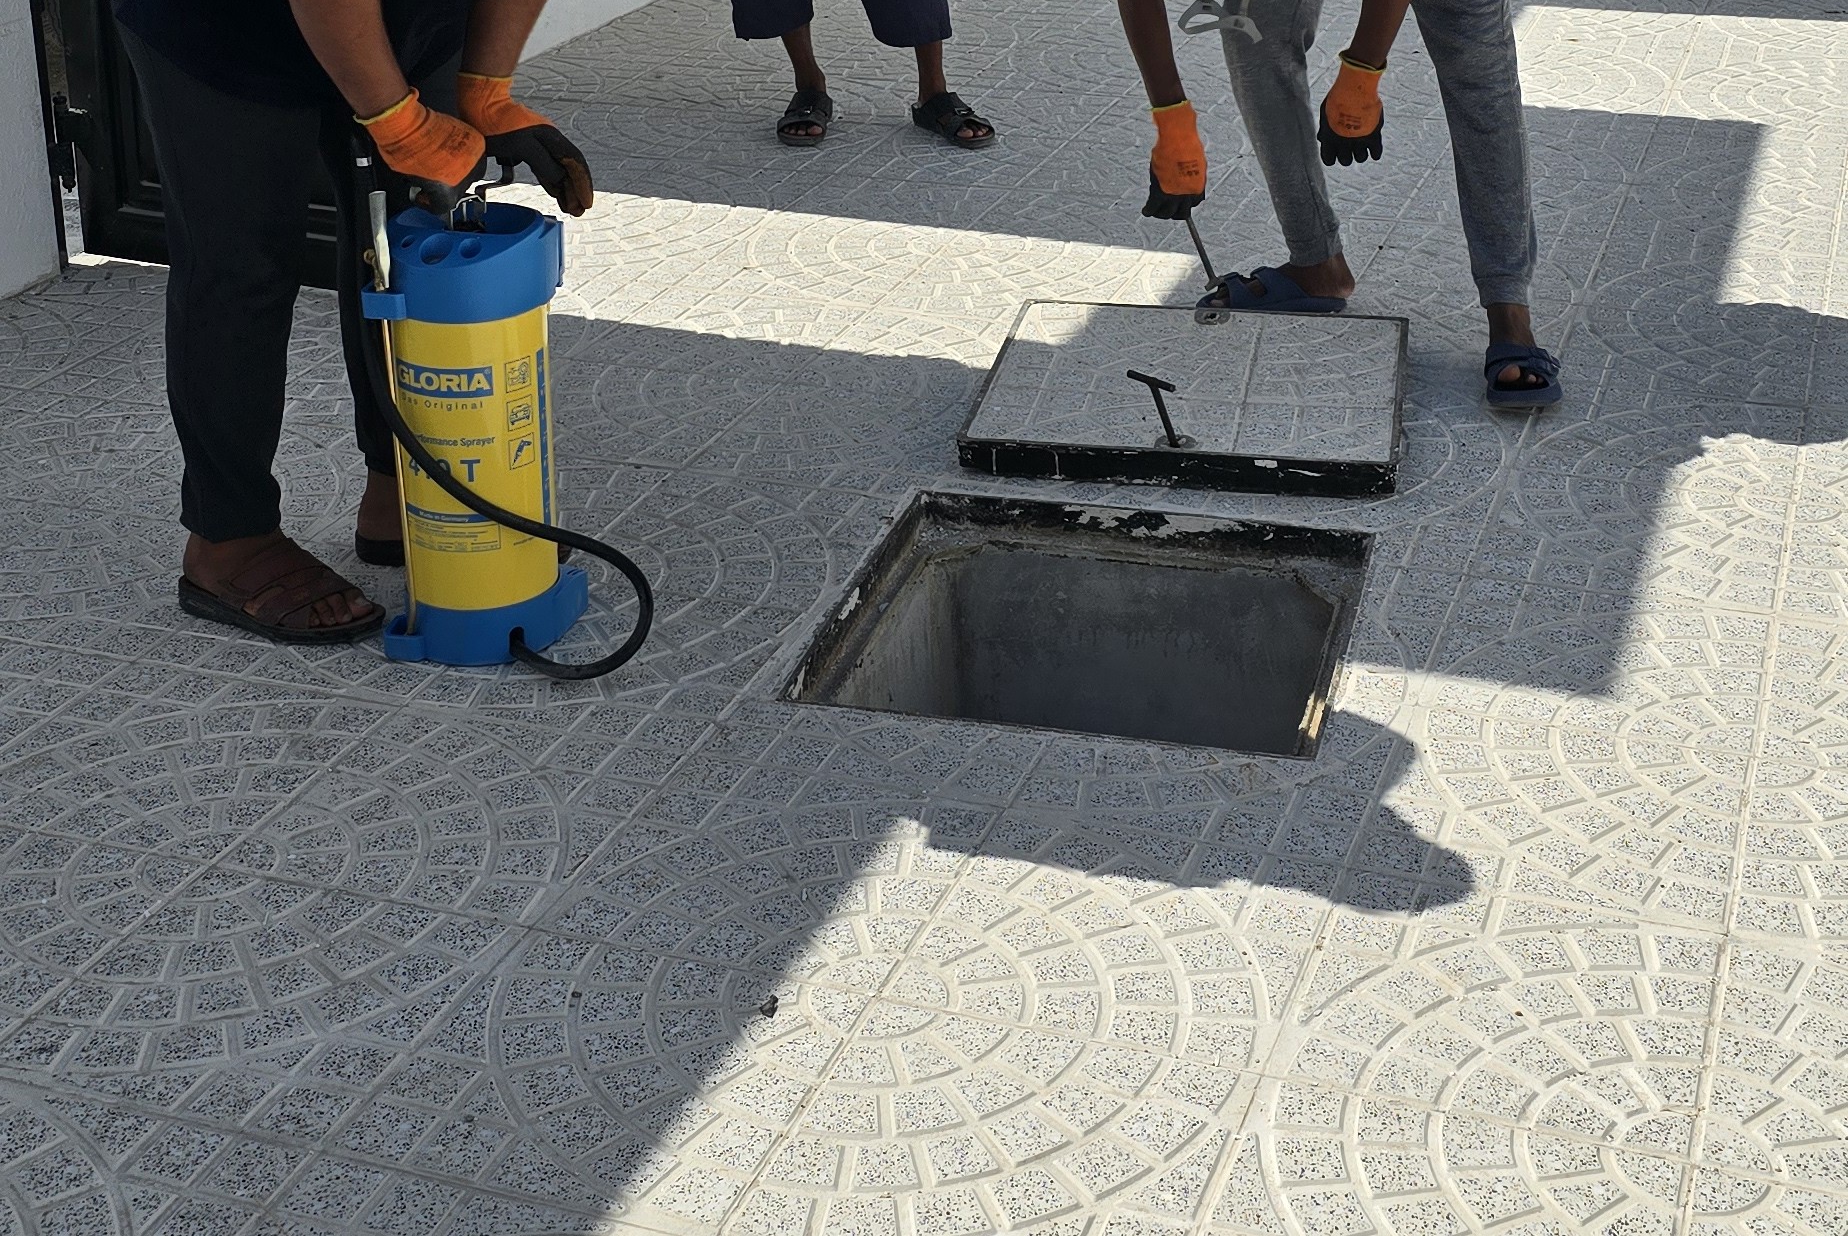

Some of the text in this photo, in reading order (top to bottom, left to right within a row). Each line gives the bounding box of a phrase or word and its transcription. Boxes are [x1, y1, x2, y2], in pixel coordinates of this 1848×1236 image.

[424, 400, 483, 411] Original
[460, 437, 495, 447] Sprayer
[460, 459, 480, 482] T
